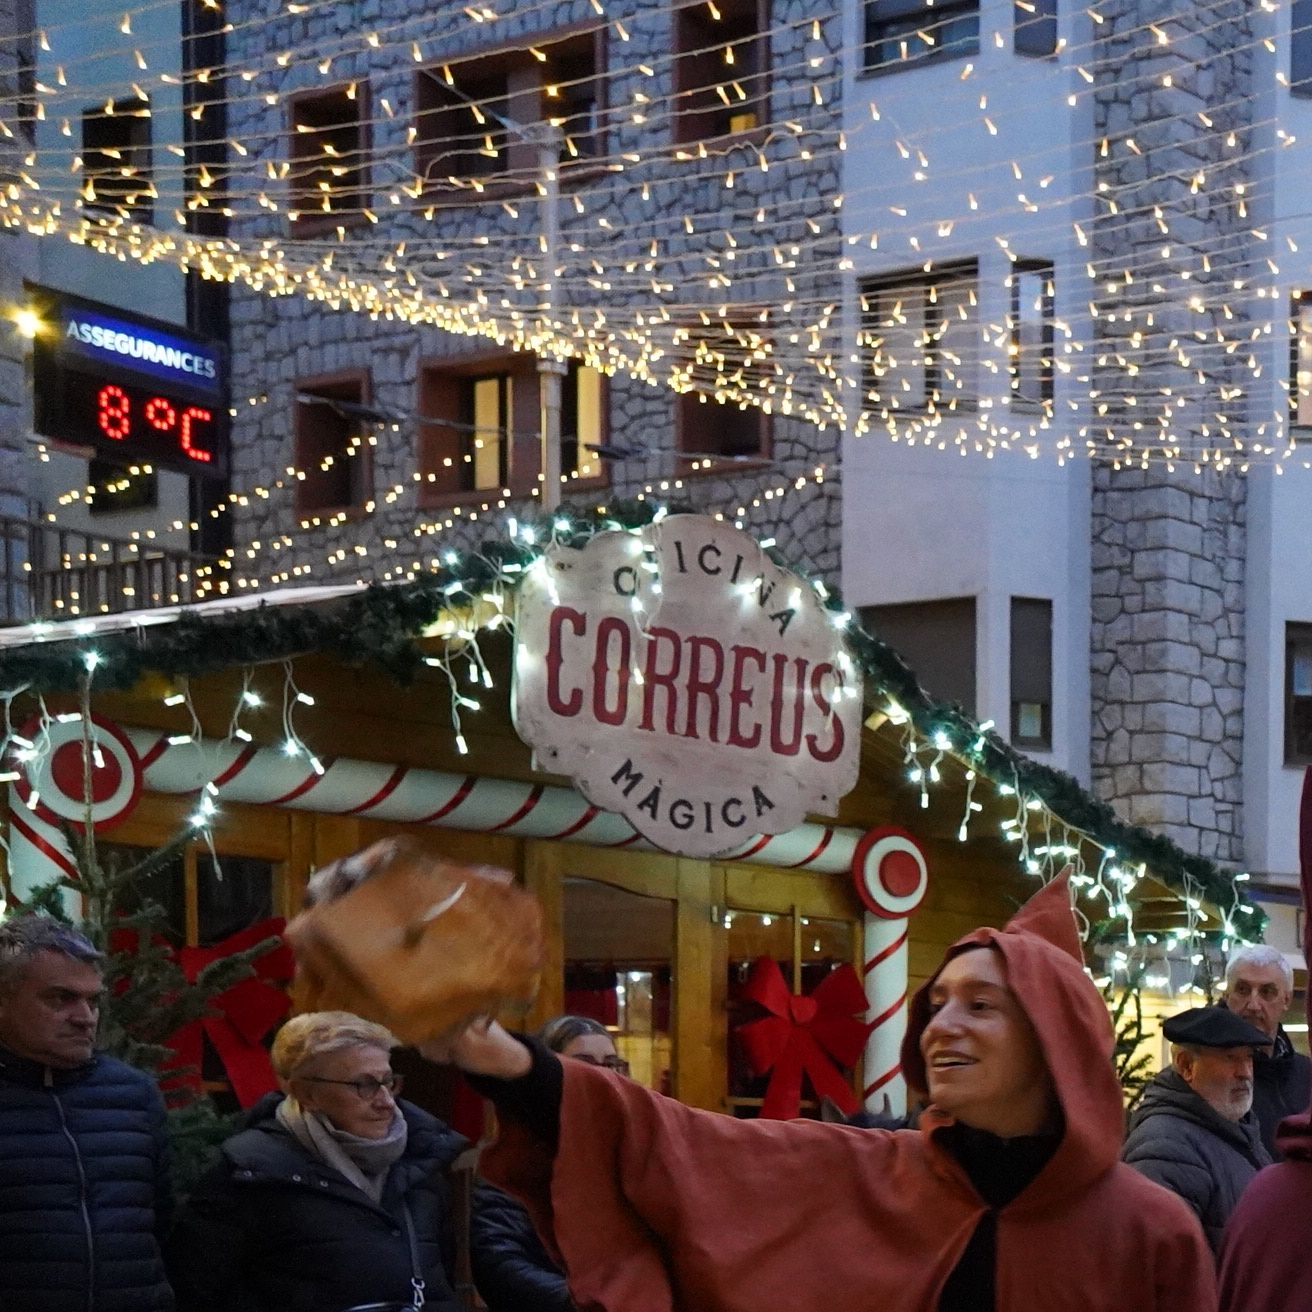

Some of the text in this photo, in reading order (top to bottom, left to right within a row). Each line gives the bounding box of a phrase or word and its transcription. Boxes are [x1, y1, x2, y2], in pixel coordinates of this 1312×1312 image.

[66, 319, 216, 378] ASSEGURANCES
[613, 540, 796, 637] OICINA
[546, 605, 845, 763] CORREUS
[611, 758, 775, 833] MÀGICA
